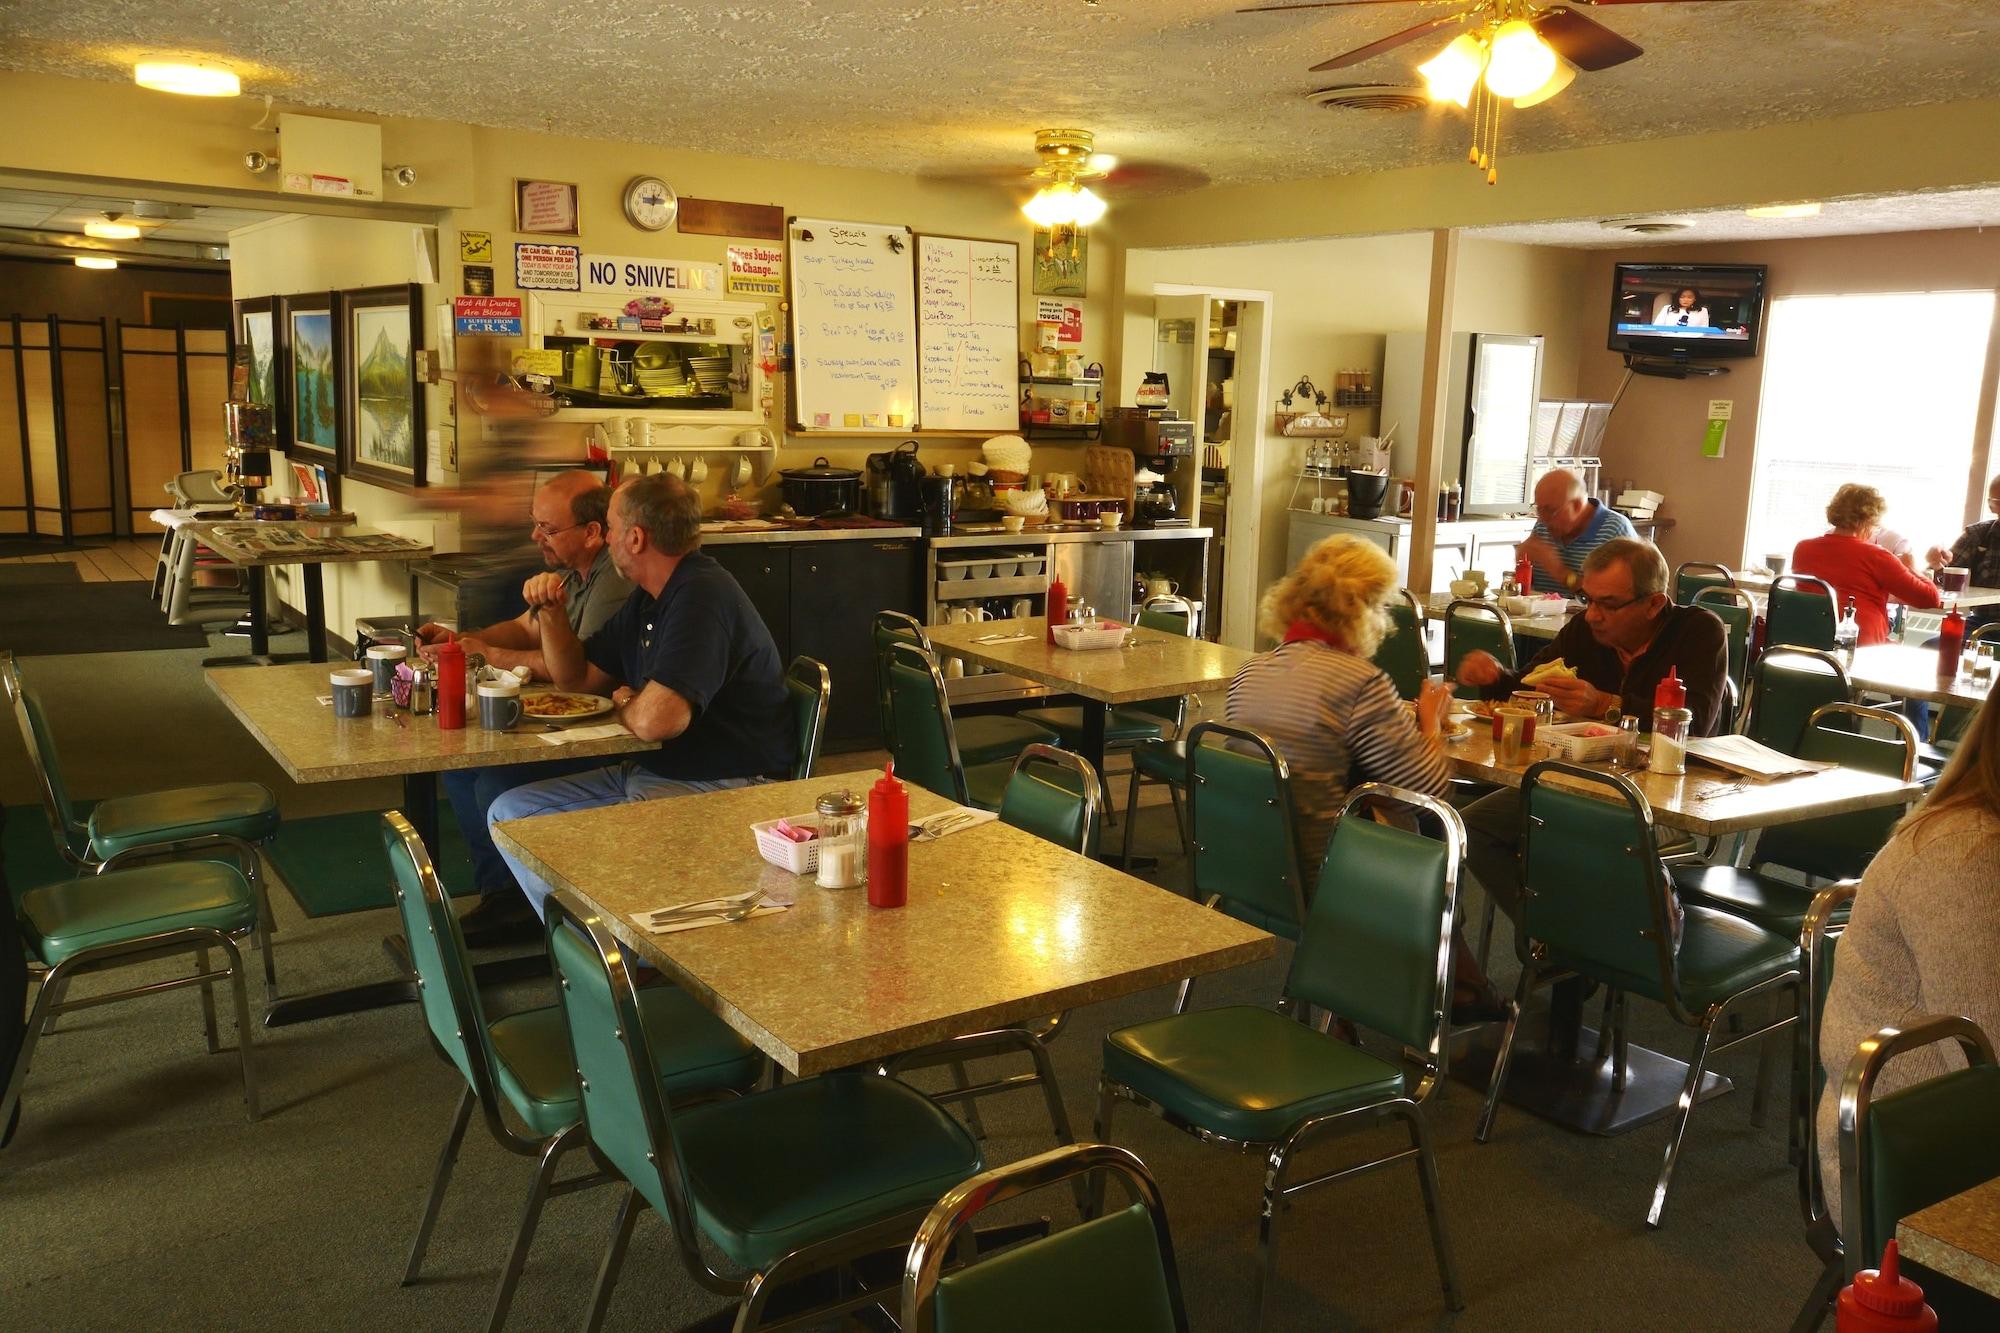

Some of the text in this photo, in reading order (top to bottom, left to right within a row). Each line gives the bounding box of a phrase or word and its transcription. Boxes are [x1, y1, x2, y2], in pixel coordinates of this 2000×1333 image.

[828, 226, 867, 240] Specials
[1058, 224, 1087, 237] LUNH
[729, 247, 782, 264] ices Subject
[925, 243, 954, 258] Muffins
[828, 255, 854, 267] Turkey
[854, 257, 875, 265] Noodle
[995, 253, 1011, 264] Buns
[731, 261, 742, 272] To
[590, 262, 616, 286] NO
[732, 281, 781, 293] ATTITUDE
[814, 282, 896, 299] Tuna Salad Sandwich
[923, 281, 953, 298] Blueberry
[489, 299, 518, 308] Dumbs
[833, 299, 847, 309] Fries
[856, 302, 871, 311] Soup
[463, 308, 513, 316] Are Blonde
[938, 310, 954, 320] Bran
[819, 322, 841, 336] Beef
[844, 325, 858, 336] Dip
[946, 327, 968, 339] Herbal
[923, 342, 943, 351] Green
[923, 366, 937, 374] Earl
